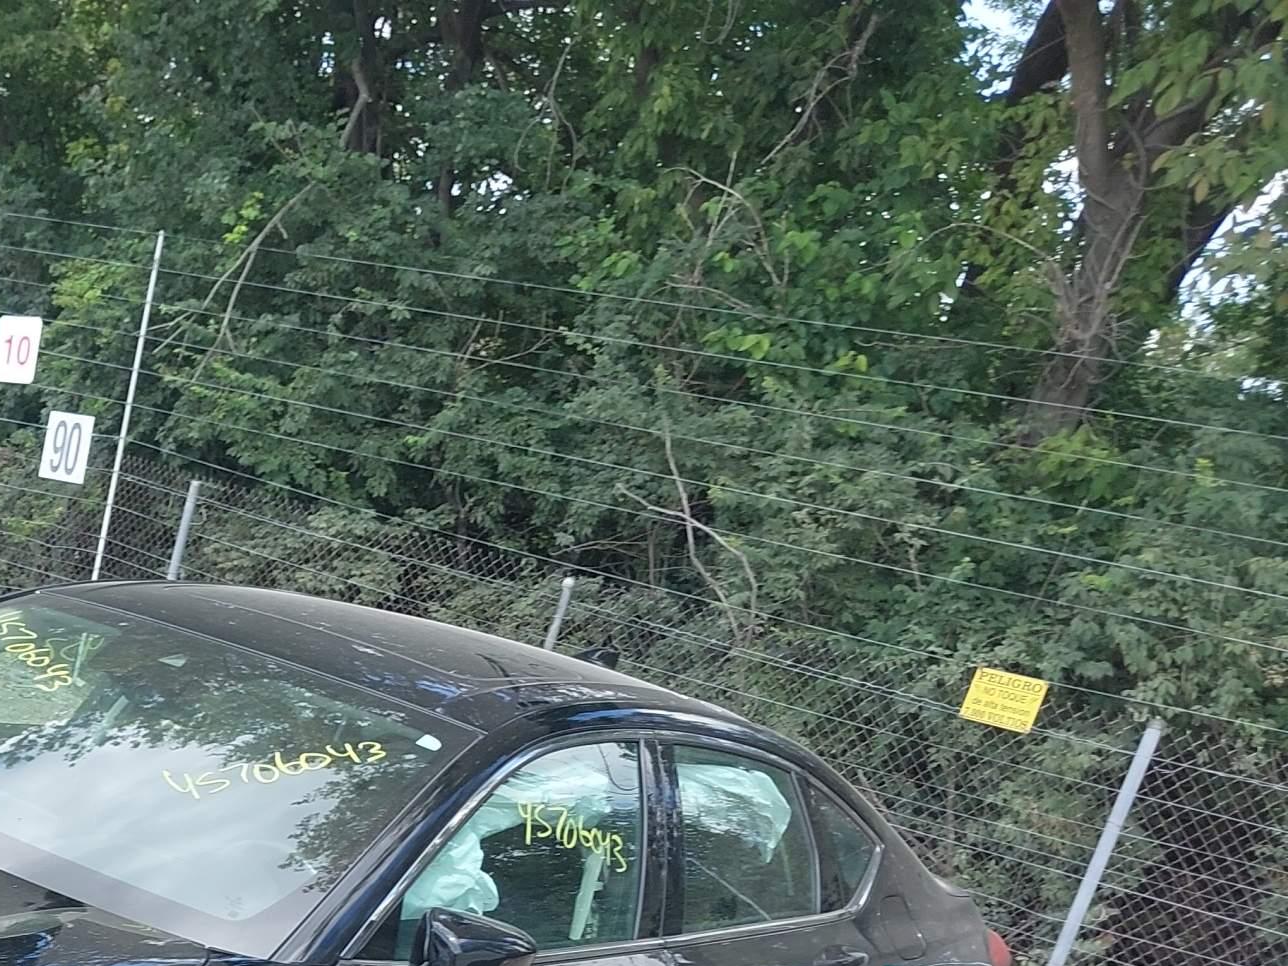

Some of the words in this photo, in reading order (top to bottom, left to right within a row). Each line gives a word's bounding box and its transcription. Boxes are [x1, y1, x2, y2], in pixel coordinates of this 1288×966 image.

[4, 335, 31, 365] 10
[50, 420, 82, 476] 90
[978, 671, 1043, 694] PELIGRO
[163, 741, 387, 799] 45706043
[517, 801, 627, 873] 45706043
